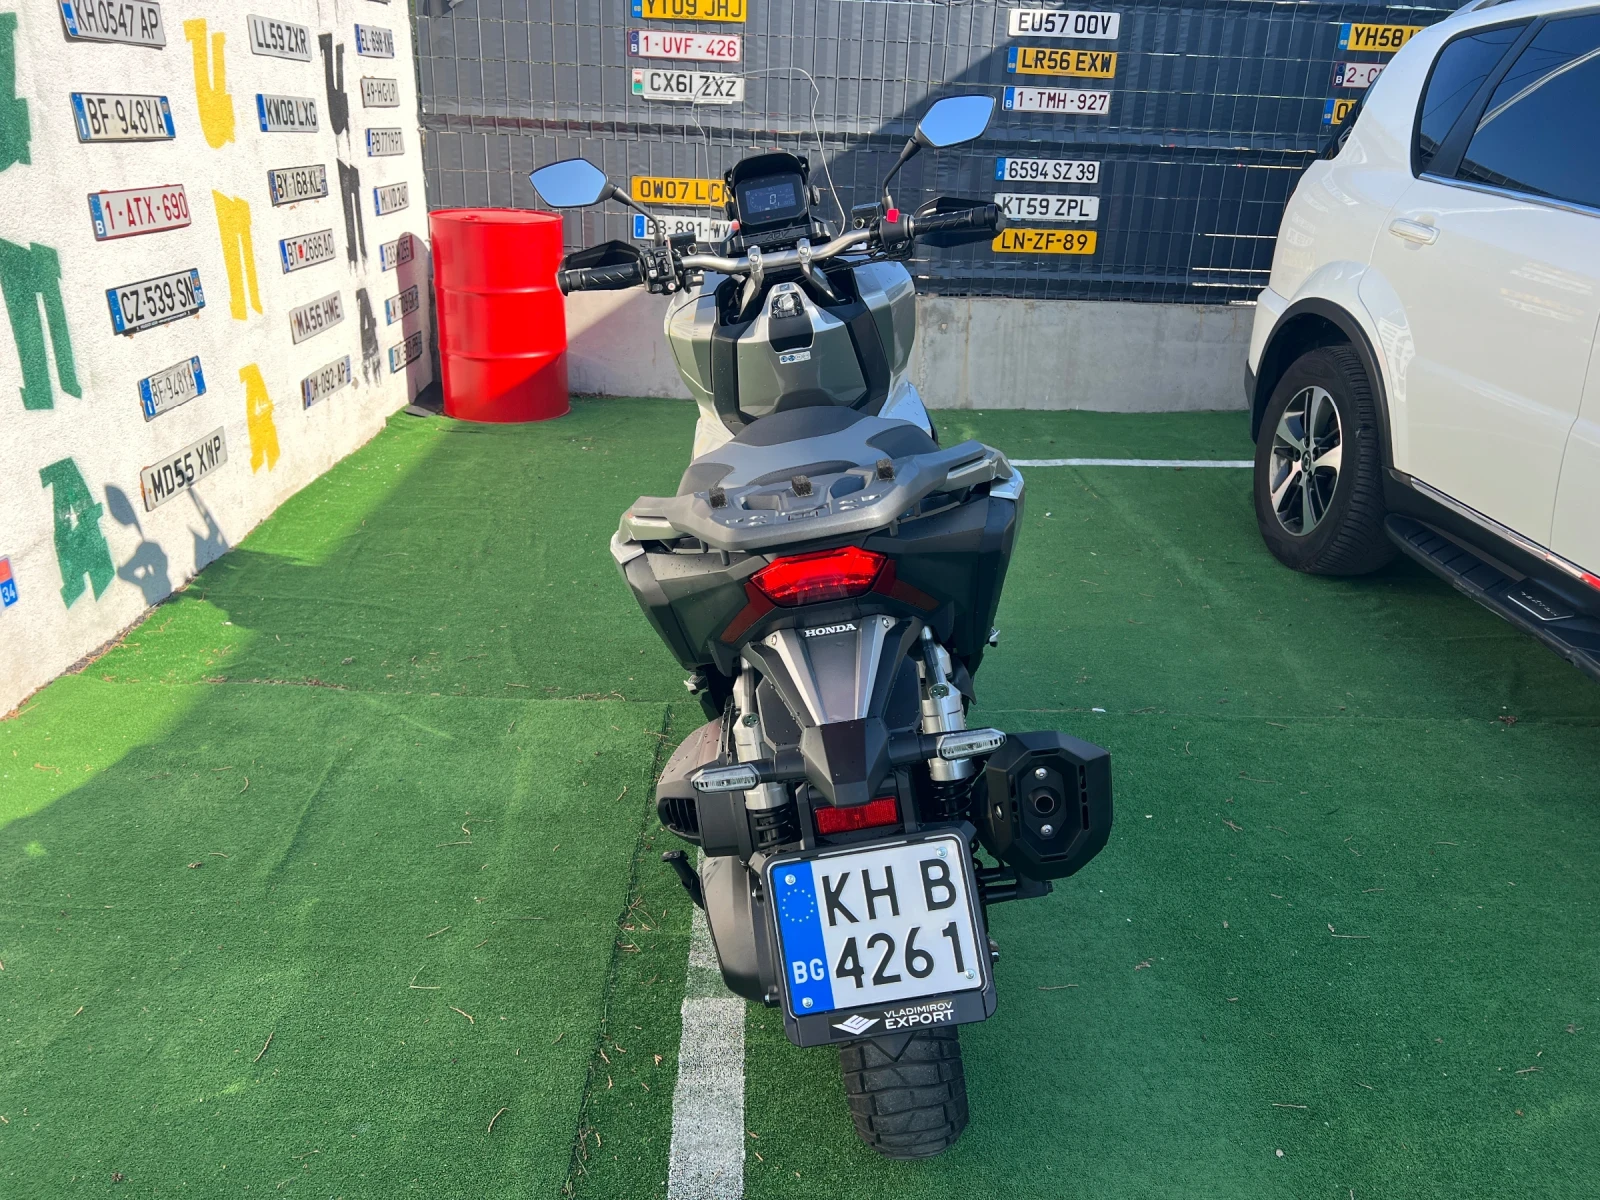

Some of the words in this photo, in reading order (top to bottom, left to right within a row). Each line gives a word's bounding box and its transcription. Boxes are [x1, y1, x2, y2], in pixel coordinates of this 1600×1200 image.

[140, 7, 159, 39] AP
[1018, 12, 1069, 32] EU57
[253, 19, 286, 51] LL59
[285, 27, 308, 54] ZXR
[1355, 27, 1404, 47] YH58
[631, 44, 638, 52] B
[1021, 49, 1071, 70] LR56
[1075, 52, 1112, 72] EXW
[1006, 100, 1012, 108] B
[296, 102, 317, 127] LXG
[1009, 161, 1048, 179] 6594
[1053, 162, 1073, 180] SZ
[1076, 163, 1096, 181] 39
[640, 180, 690, 199] OW07
[1003, 197, 1050, 215] KT59
[1055, 199, 1089, 216] ZPL
[95, 220, 104, 234] B
[1002, 232, 1088, 250] LN-ZF-89
[196, 436, 221, 475] XWP
[2, 584, 16, 603] 34
[804, 623, 857, 638] HONDA
[919, 858, 957, 912] B
[835, 921, 965, 989] 4261
[792, 958, 825, 984] BG
[884, 1002, 953, 1018] VLADIMIROV
[885, 1010, 954, 1030] EXPORT
